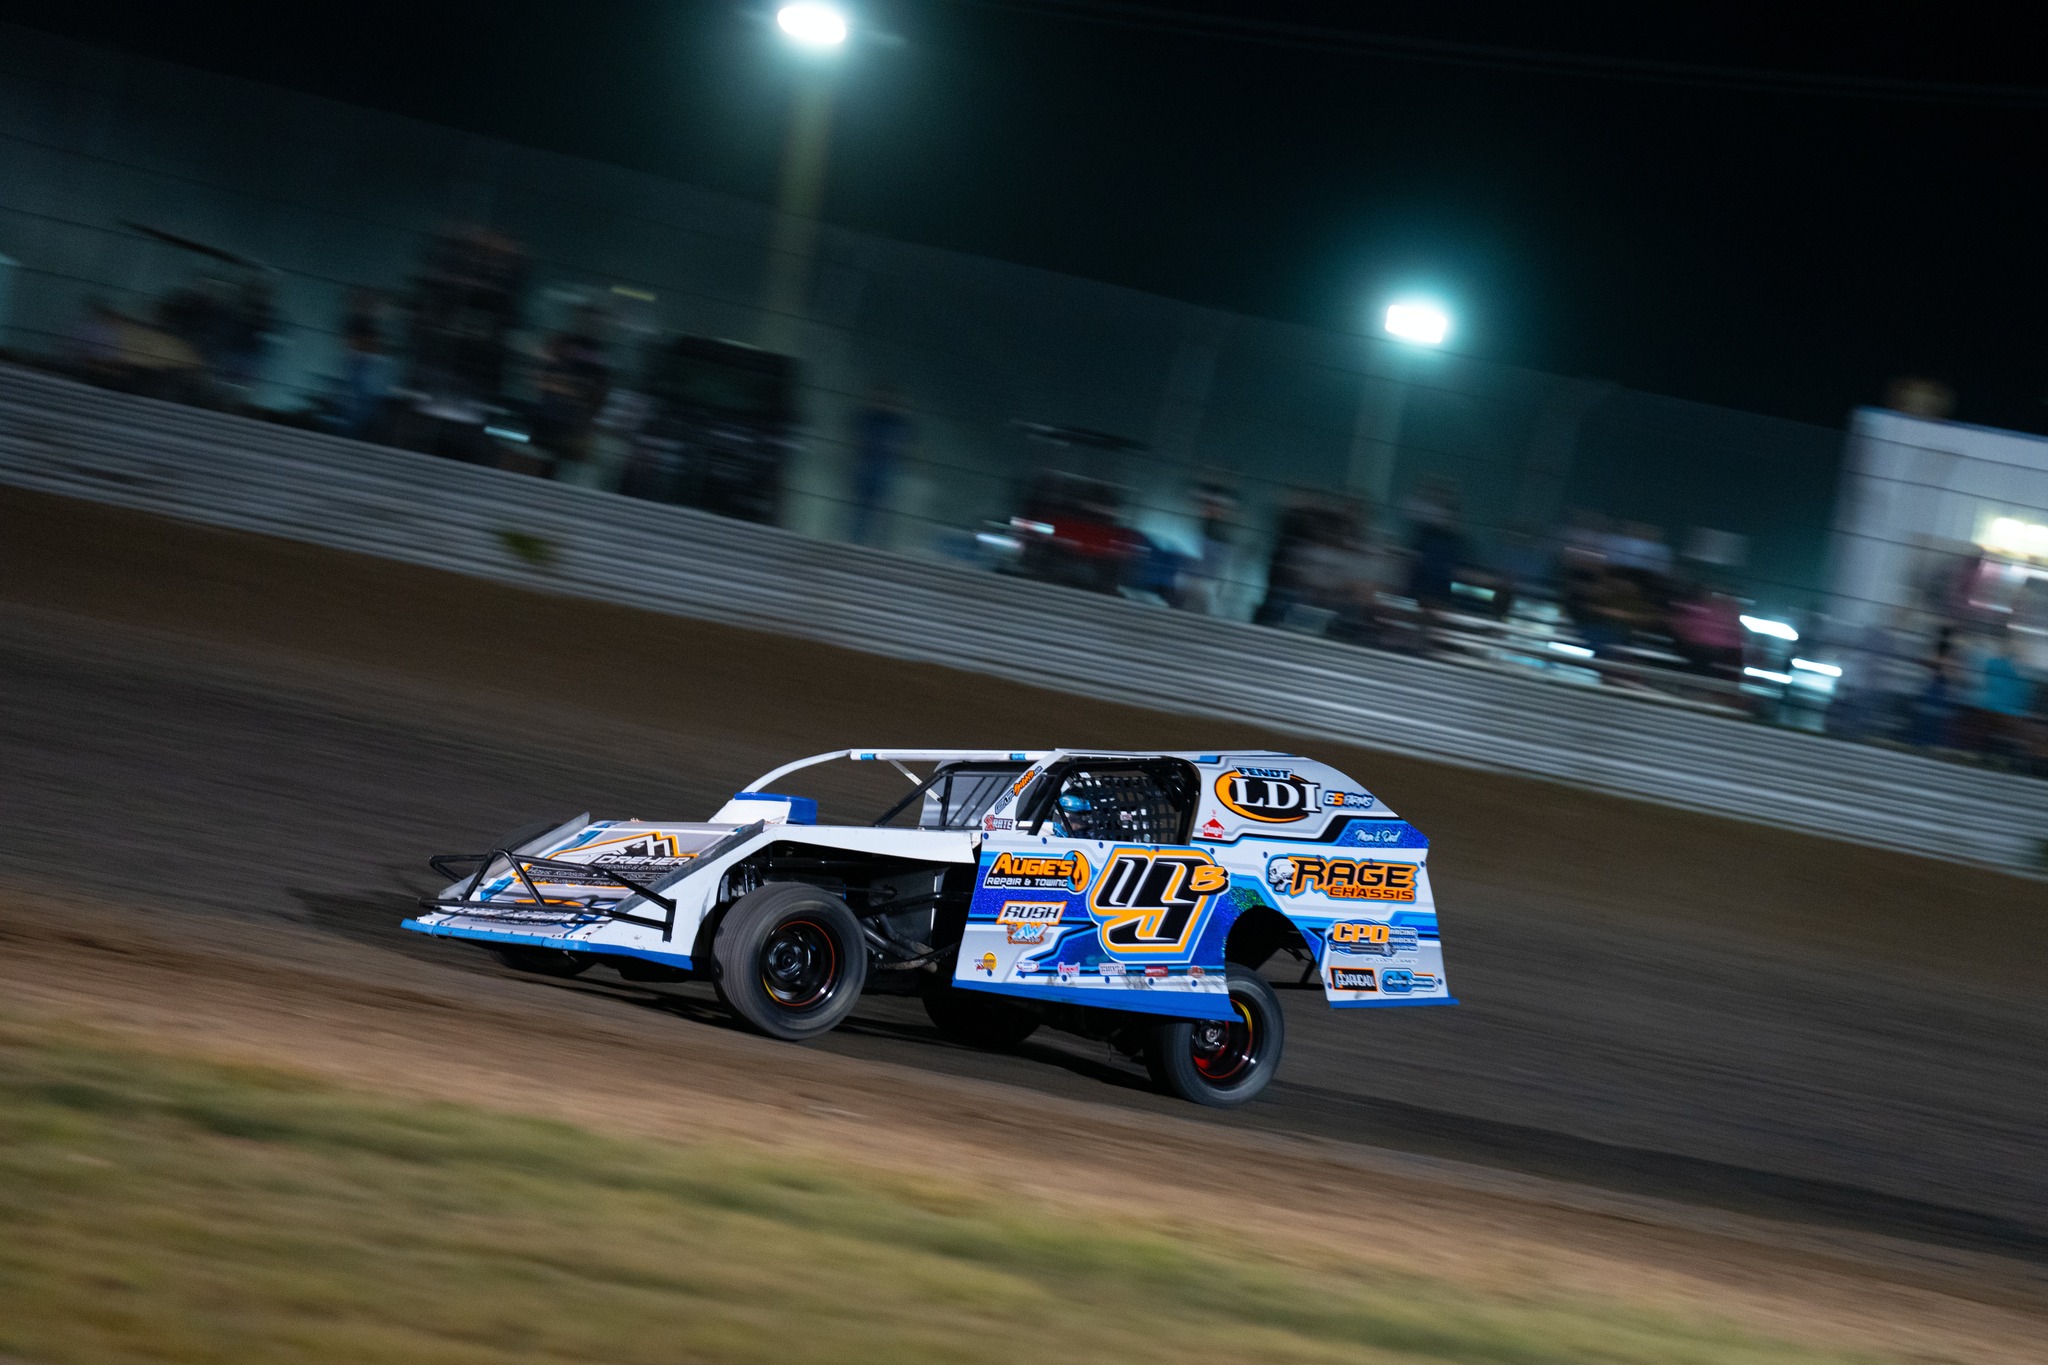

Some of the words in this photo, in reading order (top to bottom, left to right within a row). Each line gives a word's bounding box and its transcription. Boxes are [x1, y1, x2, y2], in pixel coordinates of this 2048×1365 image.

[1238, 766, 1291, 779] FENDT
[1231, 777, 1321, 812] LDI
[595, 855, 691, 865] DREHER
[992, 852, 1074, 876] AUGIE'S
[1024, 877, 1031, 886] &
[1293, 859, 1414, 891] RAGE
[1329, 886, 1413, 900] CHASSIS
[1003, 905, 1061, 919] RUSH
[1333, 923, 1390, 944] CPD
